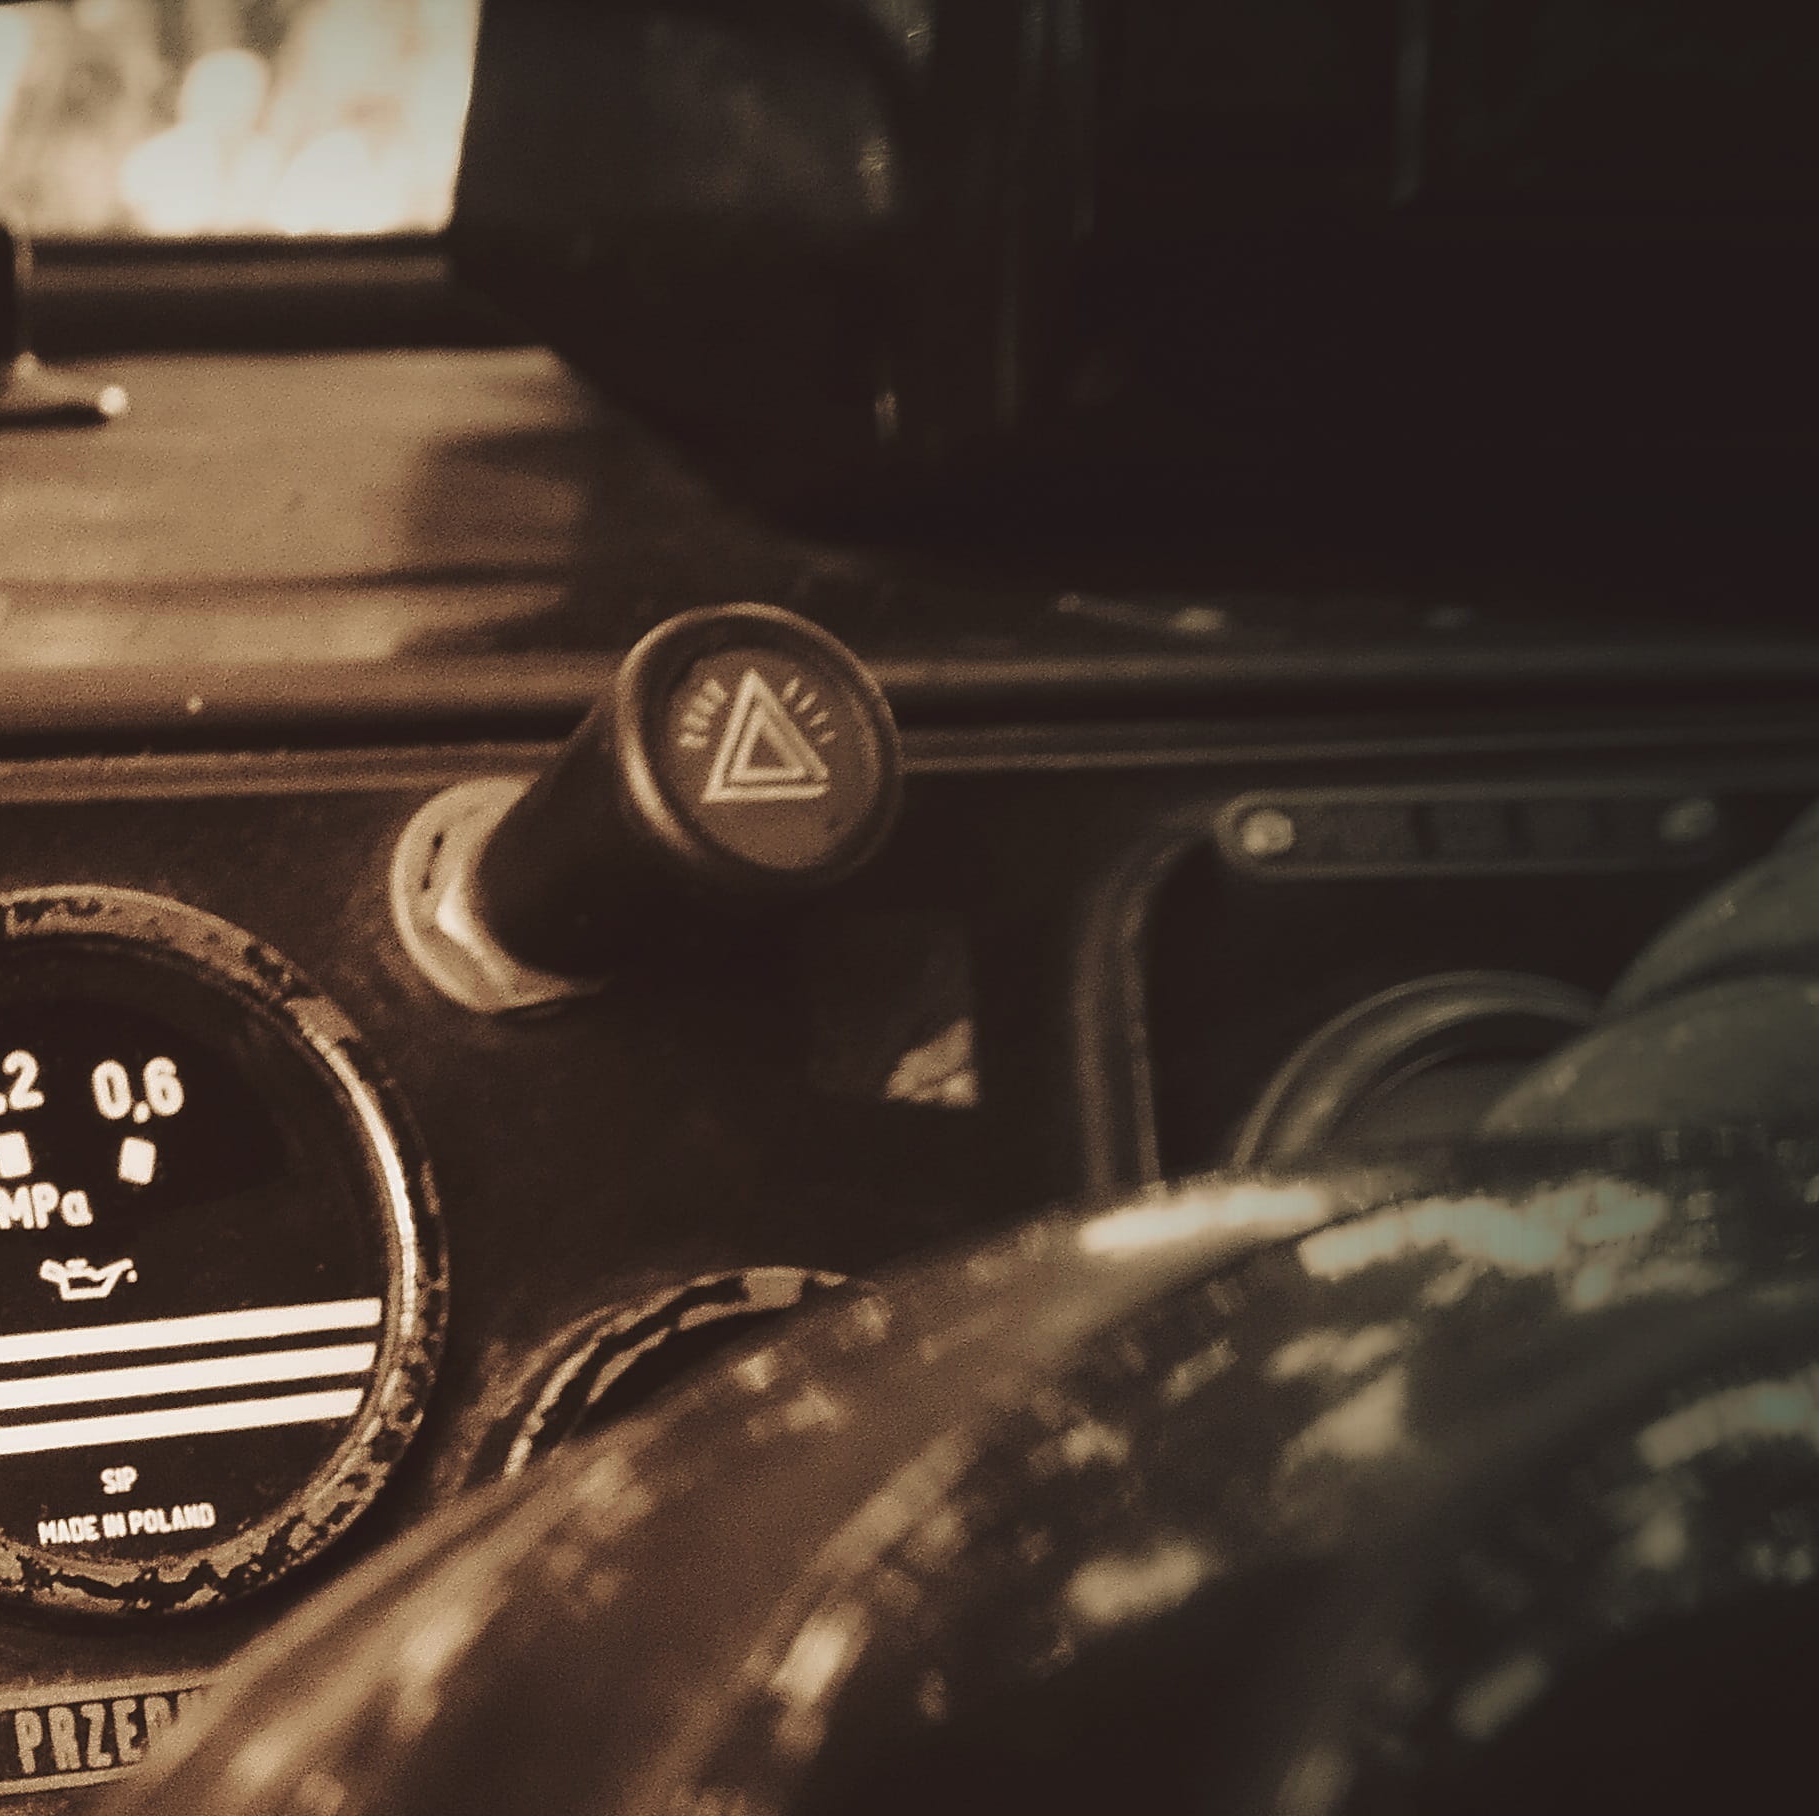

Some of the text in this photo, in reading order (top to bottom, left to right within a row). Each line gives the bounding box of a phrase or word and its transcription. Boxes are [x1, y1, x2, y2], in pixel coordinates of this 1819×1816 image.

[37, 1502, 216, 1545] MADE IN POLAND
